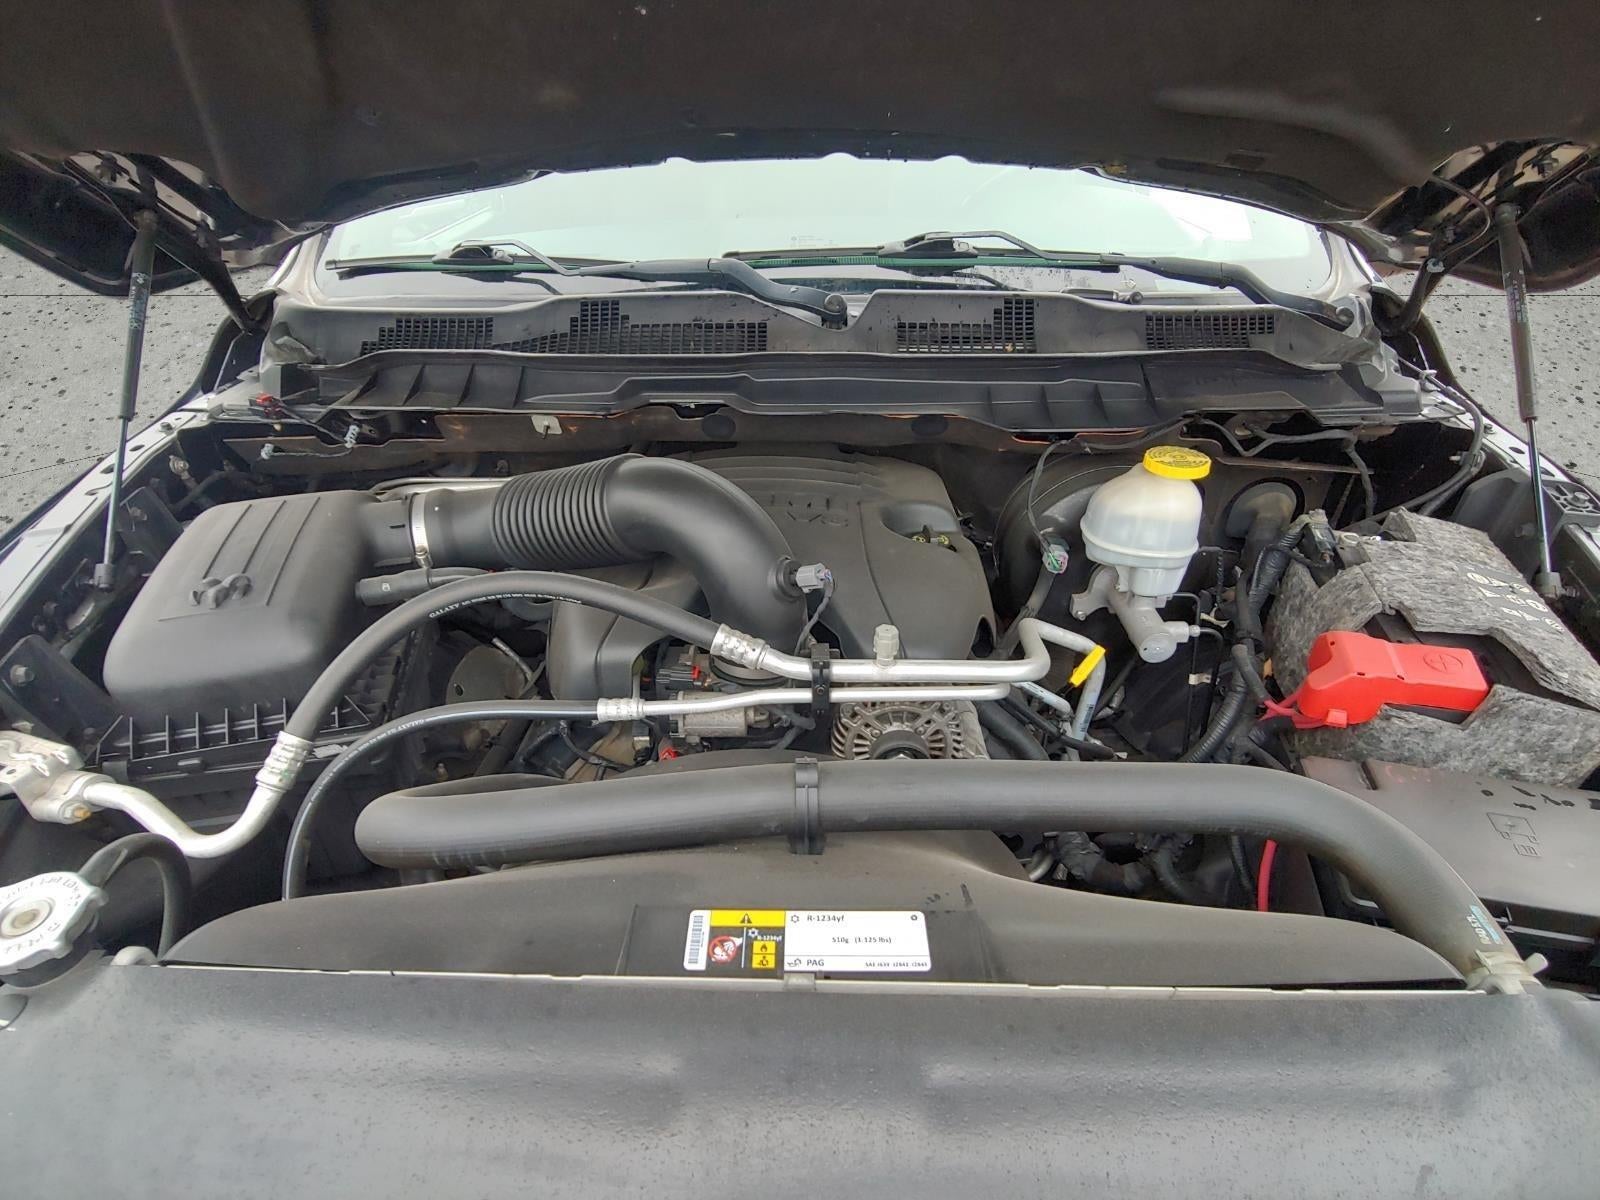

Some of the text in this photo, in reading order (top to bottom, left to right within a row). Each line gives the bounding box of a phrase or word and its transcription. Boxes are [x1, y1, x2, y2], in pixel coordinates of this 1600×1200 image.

[429, 602, 459, 618] GALAXY
[806, 914, 845, 923] R-1234yf
[806, 959, 825, 967] PAG
